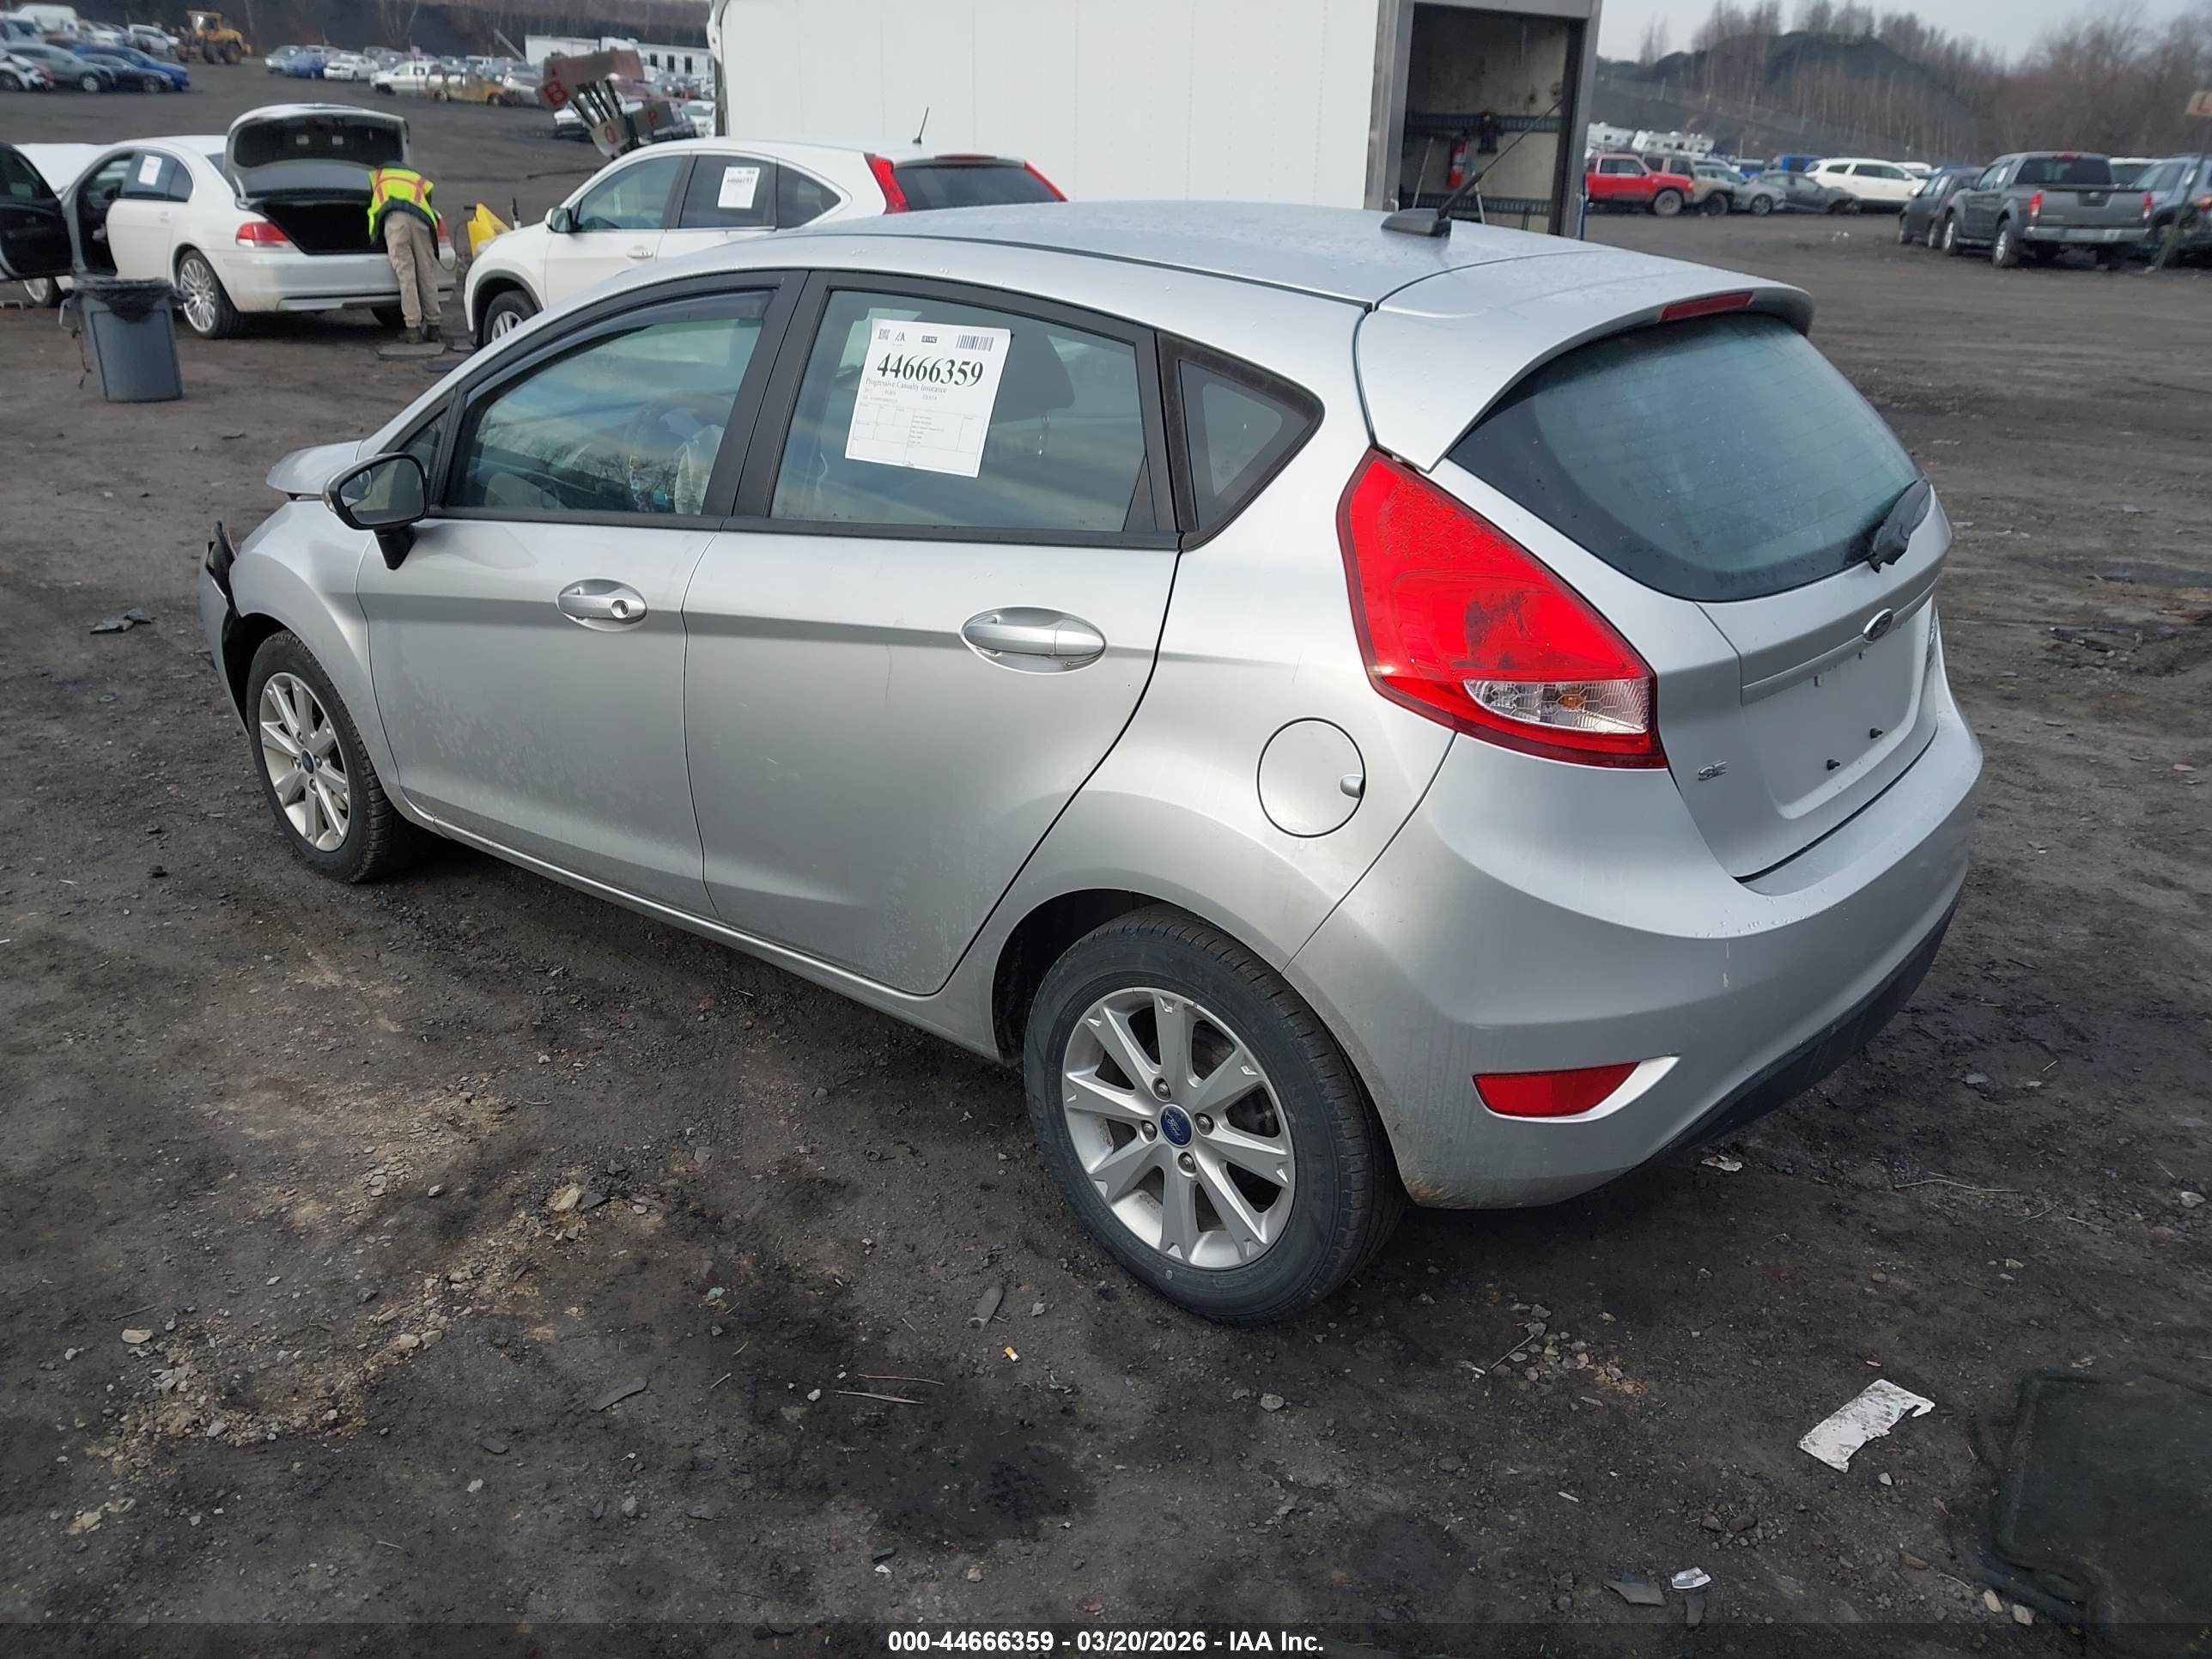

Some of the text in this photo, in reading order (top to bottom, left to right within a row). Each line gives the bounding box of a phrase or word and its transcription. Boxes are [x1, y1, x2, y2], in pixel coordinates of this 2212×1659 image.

[877, 352, 984, 387] 44666359
[866, 378, 896, 388] Progressive
[896, 381, 919, 392] Casualty
[921, 383, 947, 393] Insurance
[1698, 761, 1728, 781] SE
